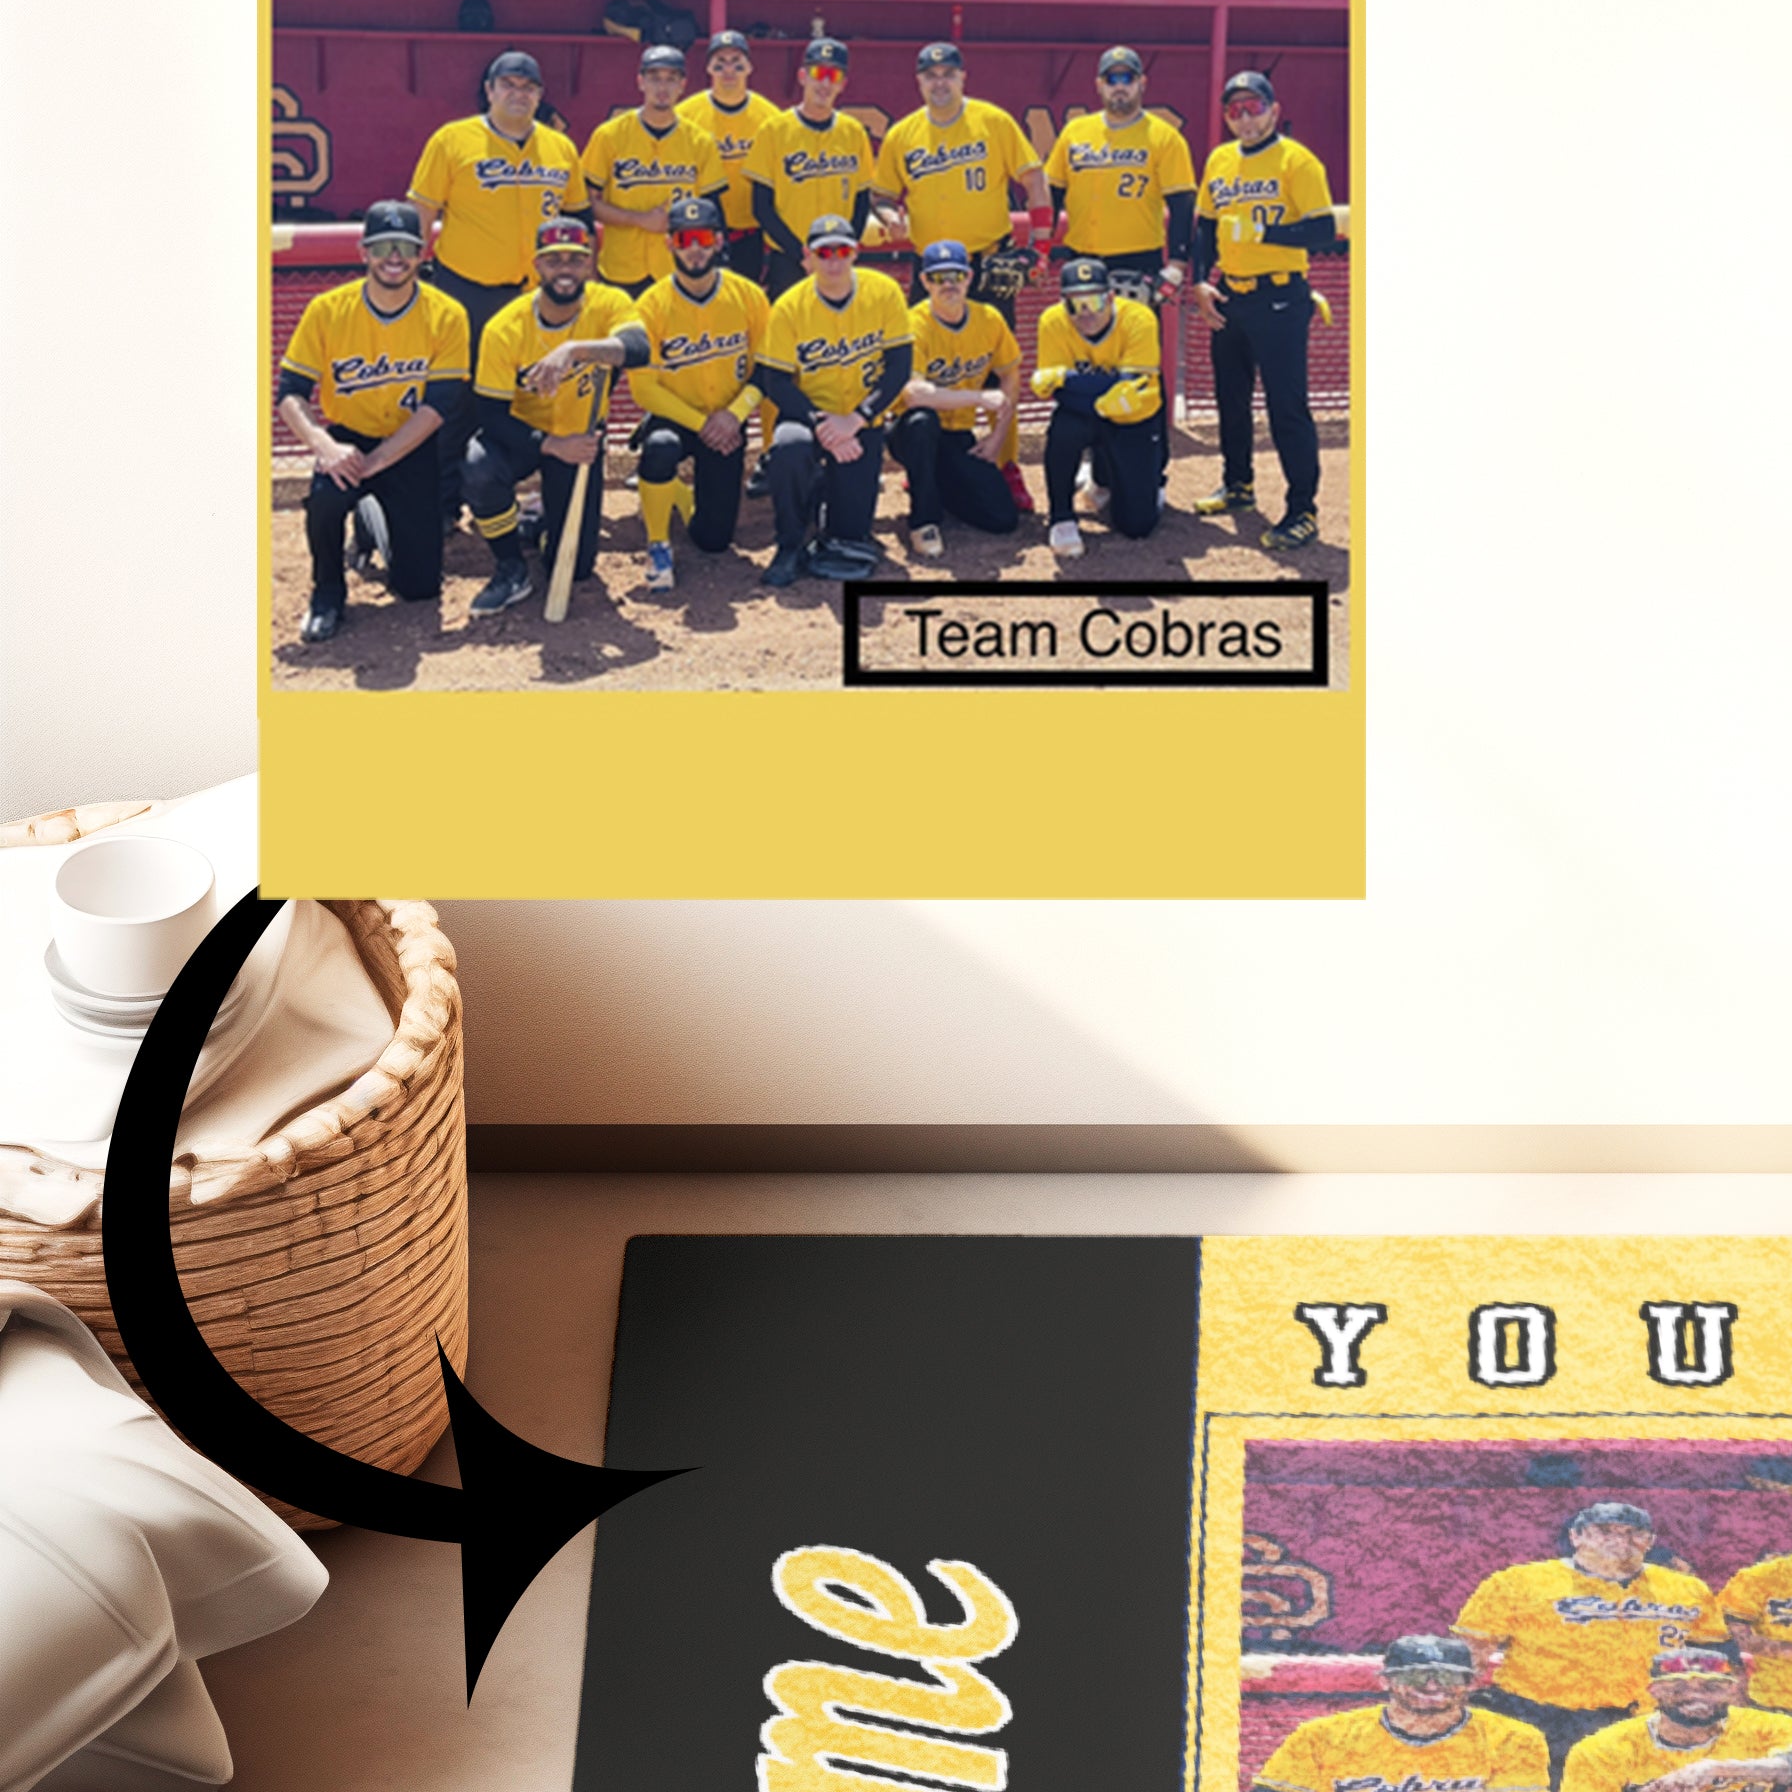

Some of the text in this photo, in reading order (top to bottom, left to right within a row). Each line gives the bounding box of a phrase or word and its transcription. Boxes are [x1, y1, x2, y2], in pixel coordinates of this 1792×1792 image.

[783, 150, 859, 182] Cobras
[905, 140, 987, 179] Cobras
[1068, 143, 1149, 170] Cobras
[474, 157, 571, 186] Cobras
[613, 157, 698, 183] Cobras
[964, 166, 987, 191] 10
[1117, 172, 1150, 198] 27
[1207, 175, 1279, 202] Cobras
[685, 204, 700, 220] C
[1076, 265, 1091, 282] C
[399, 385, 419, 411] 4
